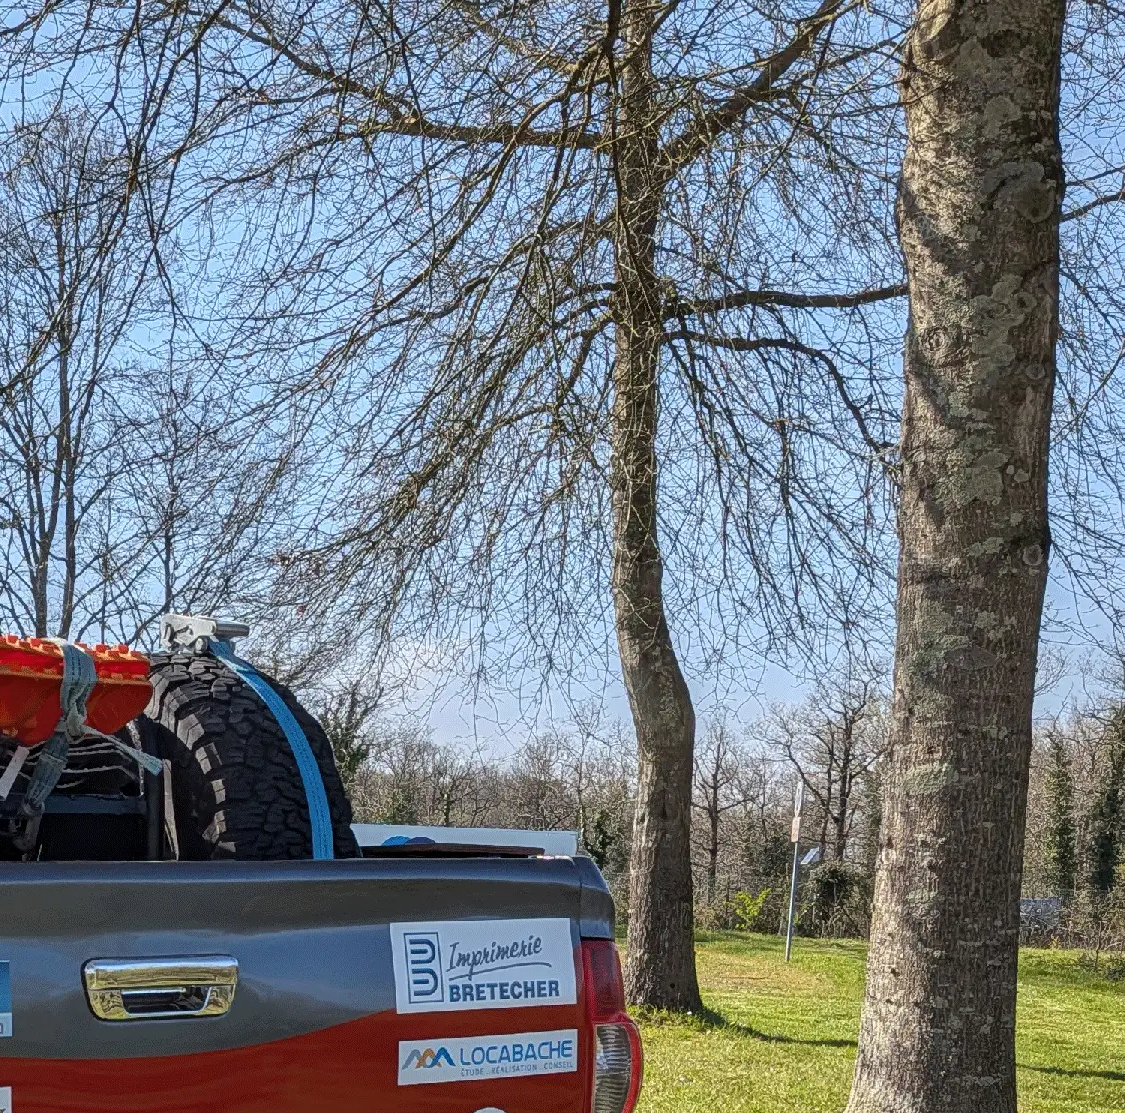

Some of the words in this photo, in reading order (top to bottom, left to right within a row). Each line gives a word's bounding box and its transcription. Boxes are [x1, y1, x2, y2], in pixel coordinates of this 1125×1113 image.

[446, 935, 543, 982] Imprimerie
[449, 980, 560, 1003] BRETECHER
[460, 1040, 573, 1066] LOCABACHE
[543, 1061, 573, 1072] CONSEIL
